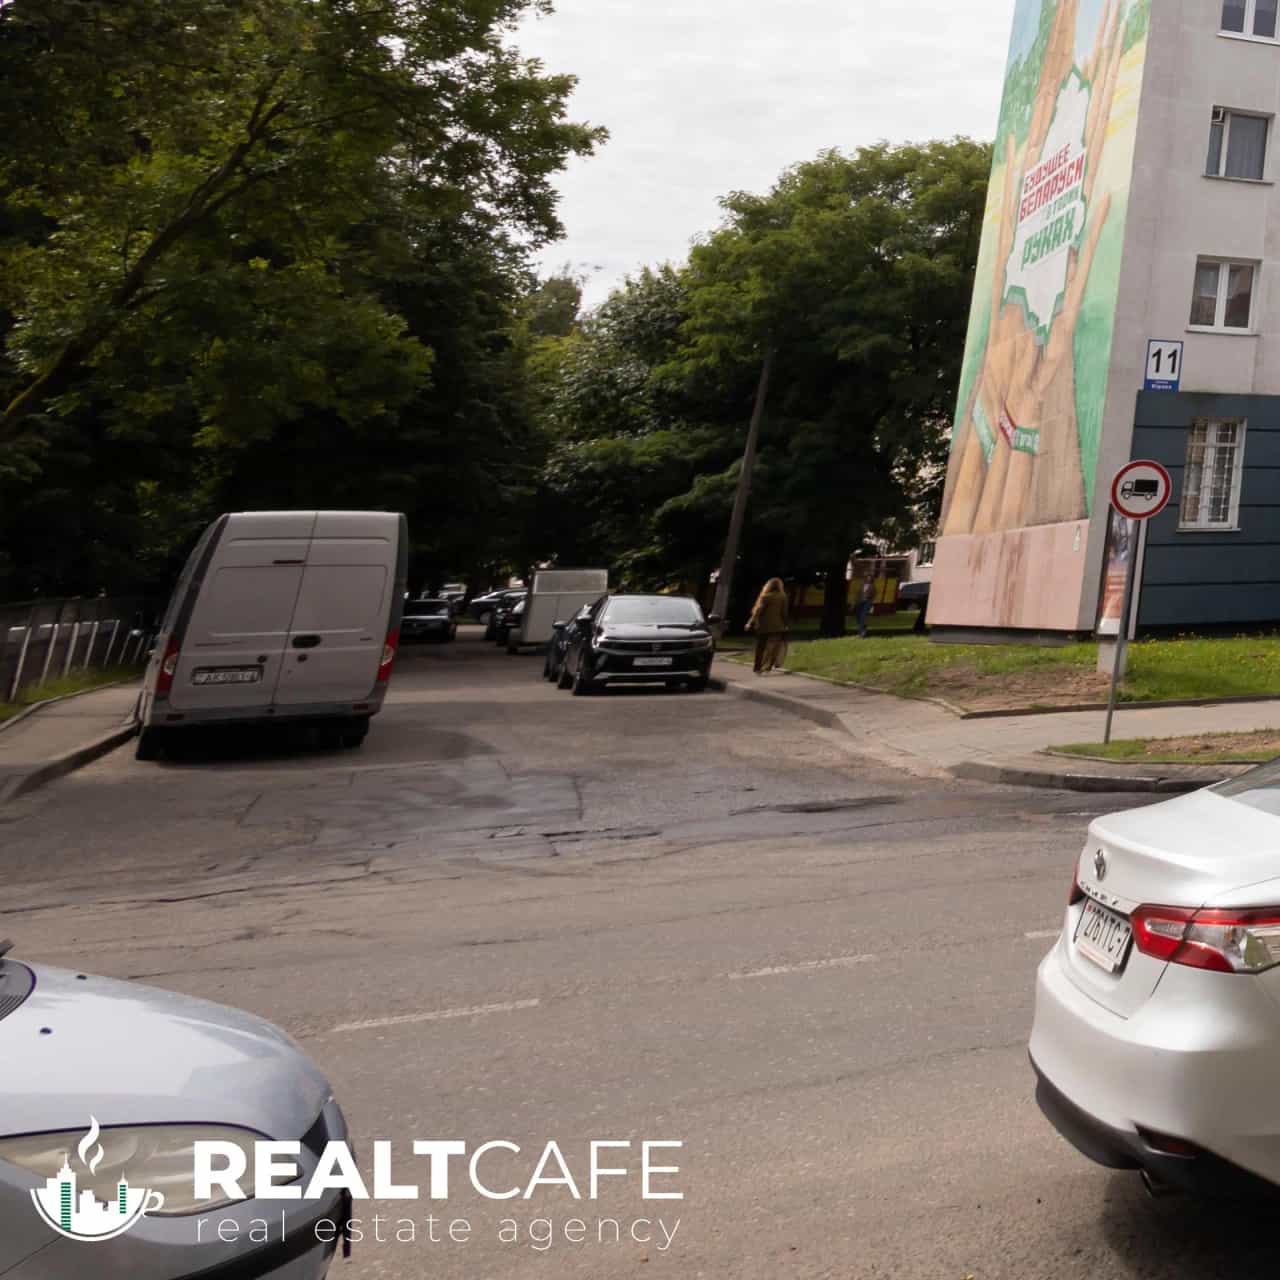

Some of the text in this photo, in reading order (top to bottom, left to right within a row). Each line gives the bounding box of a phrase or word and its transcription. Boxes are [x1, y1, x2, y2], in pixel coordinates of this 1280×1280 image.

[1020, 154, 1084, 223] БЕЛАРУСИ
[1021, 207, 1077, 271] РУКАХ
[1152, 347, 1178, 374] 11
